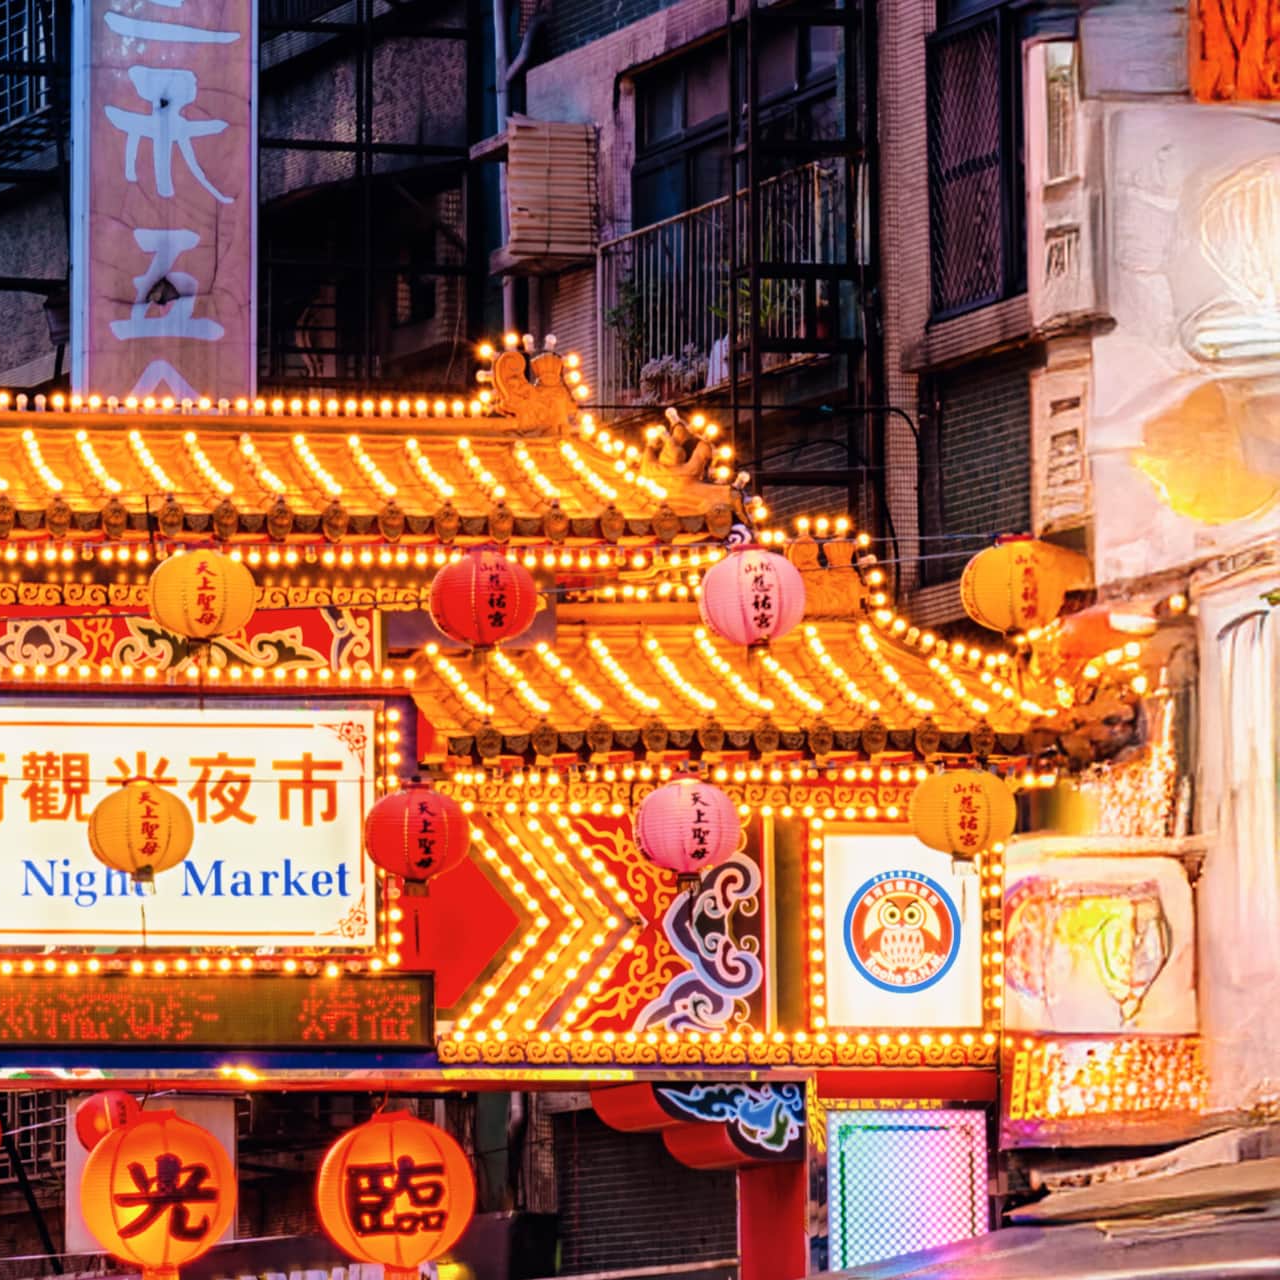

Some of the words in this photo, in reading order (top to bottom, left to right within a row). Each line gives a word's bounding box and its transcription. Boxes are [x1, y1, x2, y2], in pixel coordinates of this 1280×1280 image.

[182, 858, 352, 898] Market
[114, 1152, 218, 1242] 光
[347, 1154, 447, 1238] 臨
